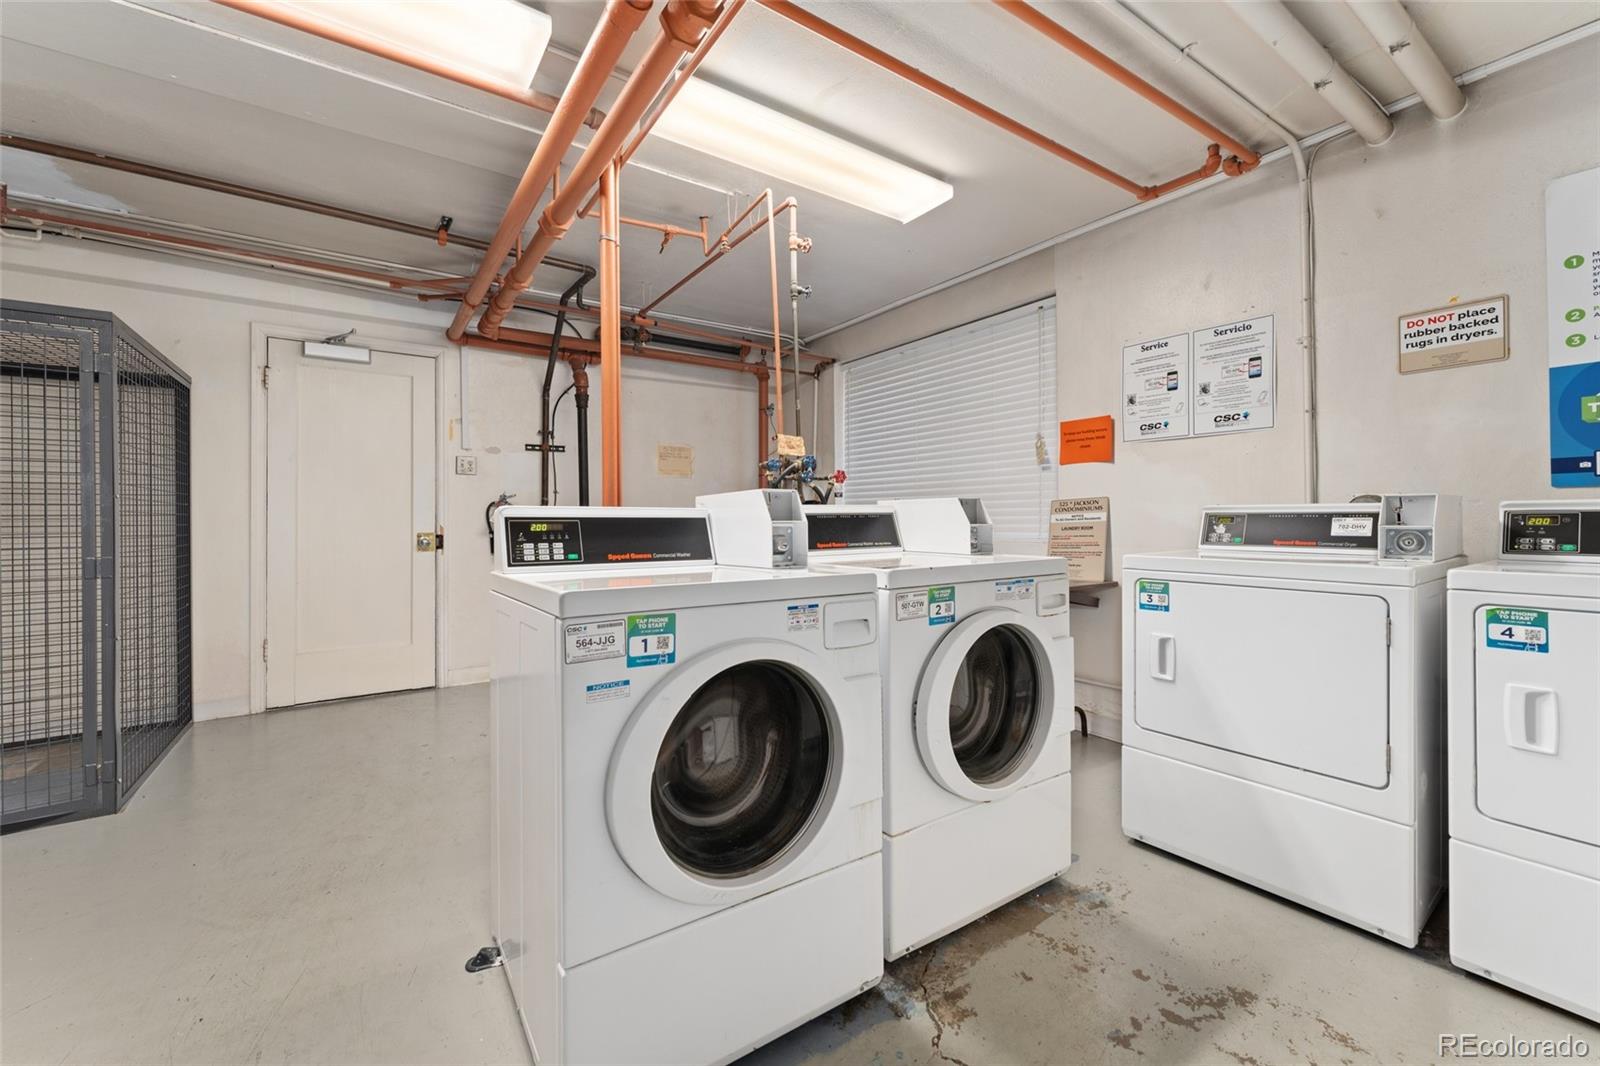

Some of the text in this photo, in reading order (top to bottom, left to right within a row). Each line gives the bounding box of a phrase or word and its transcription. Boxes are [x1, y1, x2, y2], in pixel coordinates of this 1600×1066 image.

[1570, 258, 1577, 266] 1
[1406, 306, 1496, 329] DO NOT place
[1570, 311, 1580, 320] 2
[1213, 323, 1252, 337] Servicio
[1404, 315, 1499, 340] rubber backed
[1405, 328, 1498, 349] rugs in dryers.
[1571, 336, 1580, 345] 3
[1140, 341, 1169, 353] Service
[1213, 413, 1241, 423] CSC
[1140, 422, 1163, 431] CSC
[1054, 505, 1104, 513] CONDOMINIUMS
[607, 552, 629, 560] Speed
[630, 552, 652, 560] Queen
[1146, 593, 1153, 603] 3
[901, 601, 925, 610] 507-GTW
[935, 604, 942, 615] 2
[1500, 627, 1515, 639] 4
[575, 635, 616, 649] 564-JJG
[641, 638, 648, 653] 1
[592, 681, 625, 690] NOTICE
